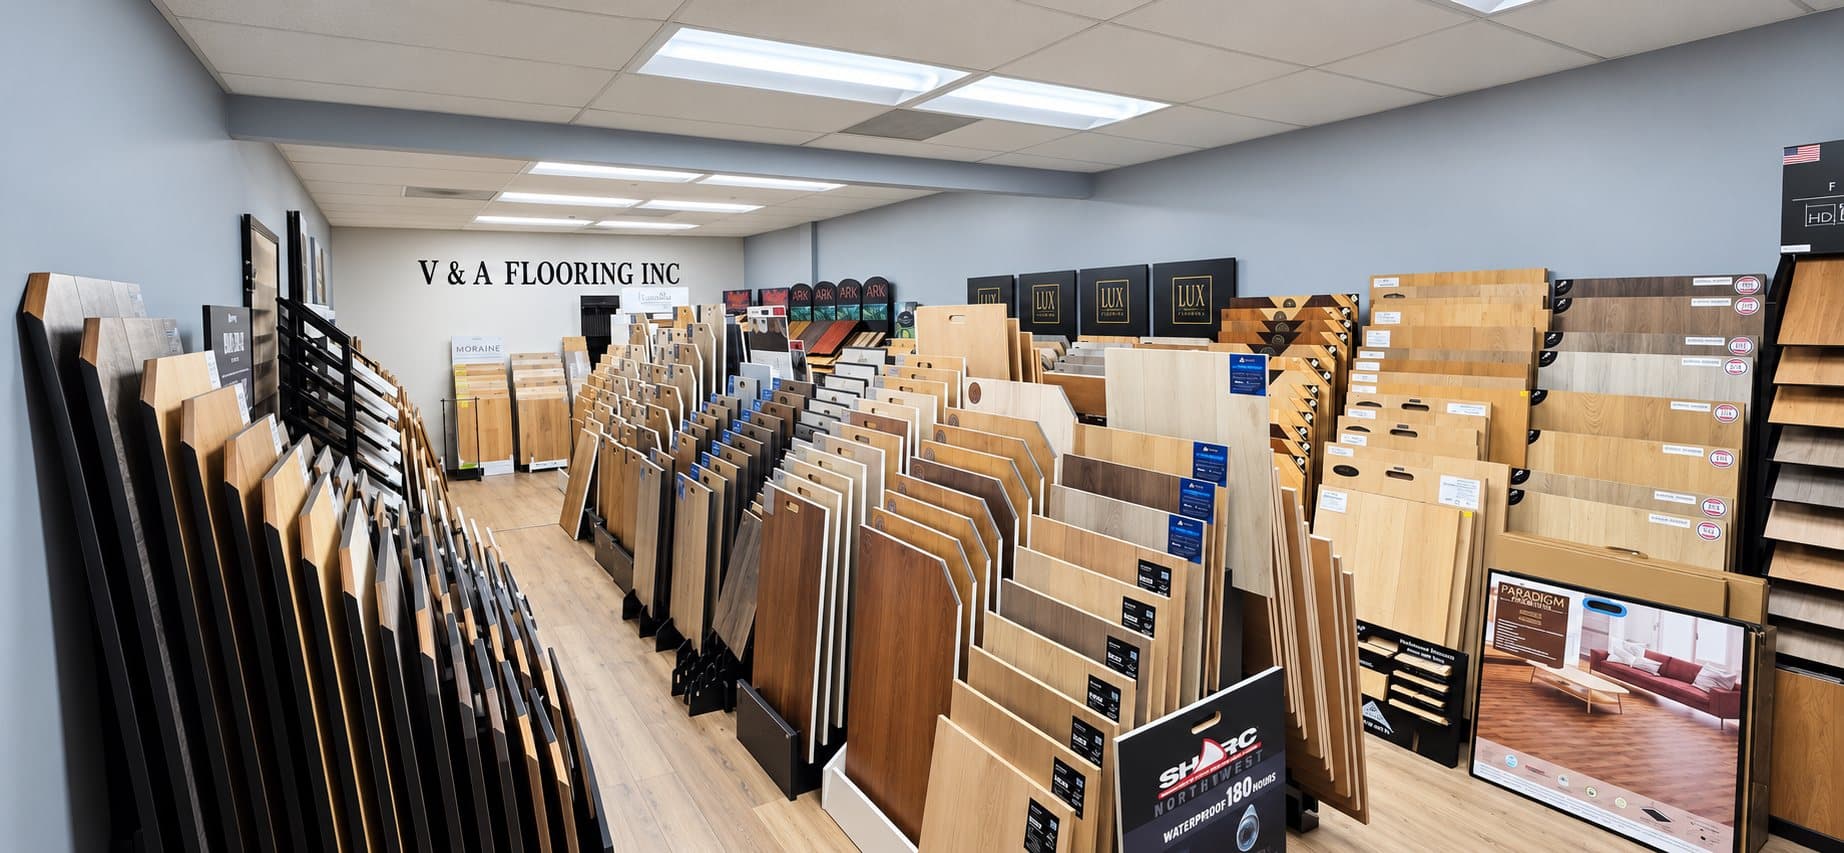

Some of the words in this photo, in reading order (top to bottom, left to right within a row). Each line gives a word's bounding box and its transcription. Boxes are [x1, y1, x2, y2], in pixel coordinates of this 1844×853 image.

[1808, 211, 1833, 224] HD
[418, 260, 439, 285] V
[447, 260, 466, 285] &
[473, 260, 492, 285] A
[504, 261, 634, 286] FLOORING
[642, 262, 680, 285] INC
[792, 289, 808, 301] ARK
[815, 287, 832, 300] ARK
[840, 286, 857, 299] ARK
[866, 284, 886, 298] ARK
[1101, 287, 1123, 308] LUX
[1177, 284, 1206, 307] LUX
[1036, 290, 1055, 310] LUX
[456, 344, 501, 353] MORAINE
[1501, 584, 1565, 608] PARADIGM
[1163, 798, 1227, 844] WATERPROOF
[1226, 776, 1253, 807] 180
